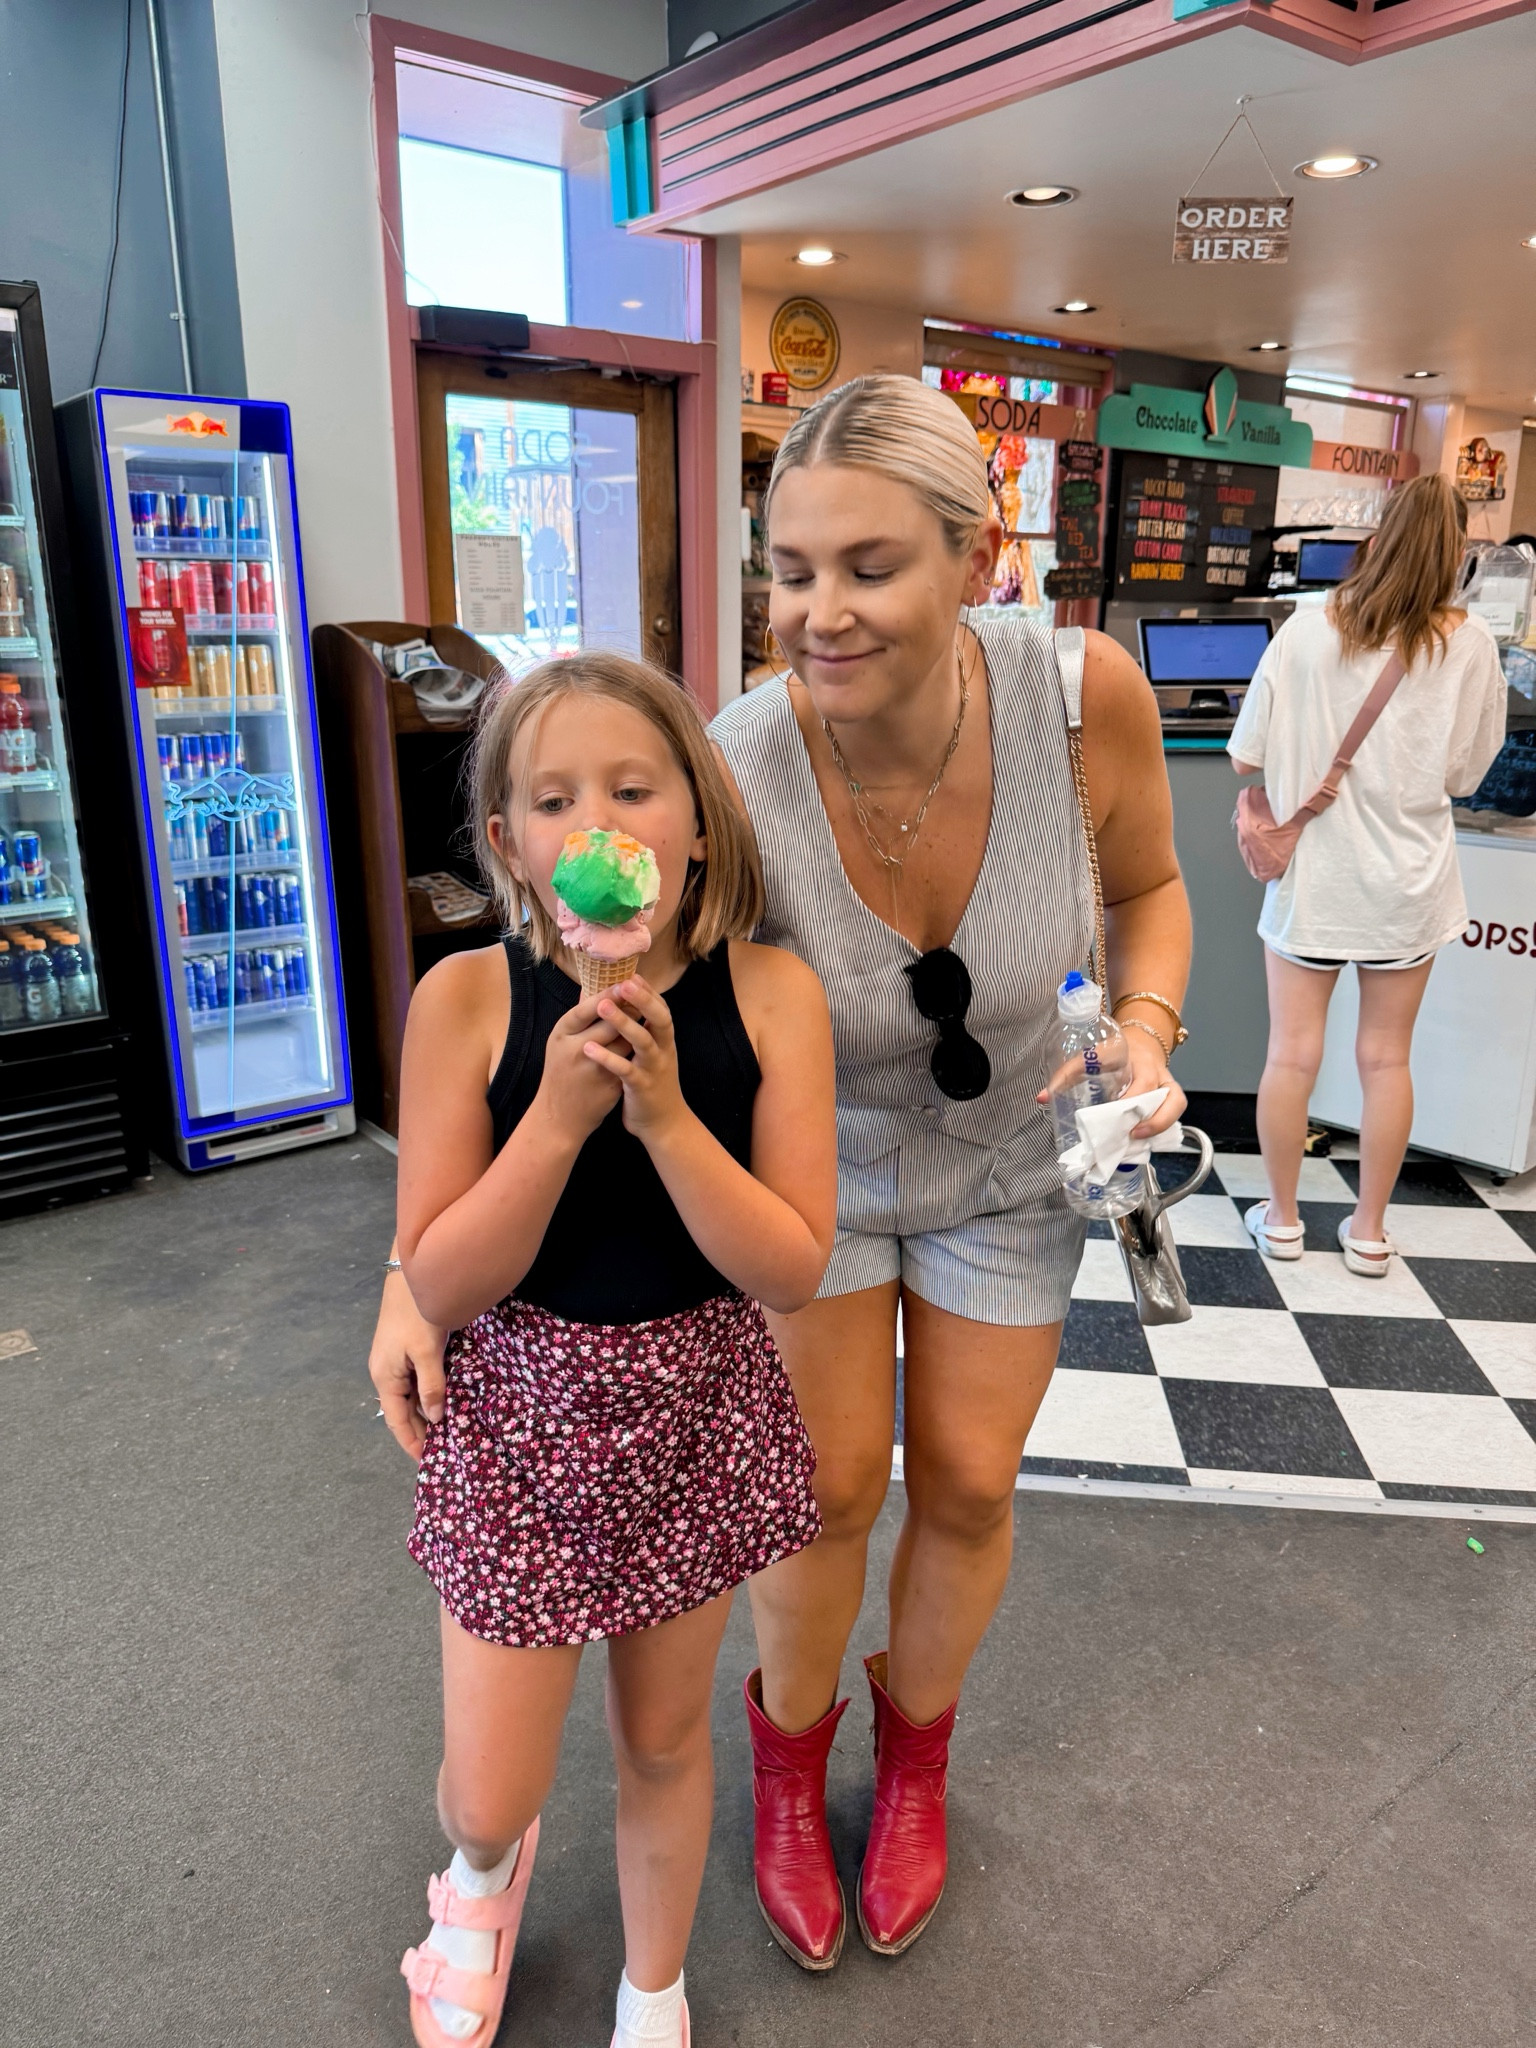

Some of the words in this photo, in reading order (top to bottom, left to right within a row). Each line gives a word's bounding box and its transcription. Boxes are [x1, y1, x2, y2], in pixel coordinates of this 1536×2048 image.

[1181, 207, 1288, 229] ORDER
[1192, 239, 1270, 260] HERE
[978, 396, 1040, 434] SODA
[1135, 405, 1198, 435] Chocolate
[1241, 421, 1281, 446] Vanilla
[1332, 446, 1400, 477] FOUNTAIN
[1137, 518, 1163, 537] BUTTER
[1163, 520, 1186, 540] PECAN
